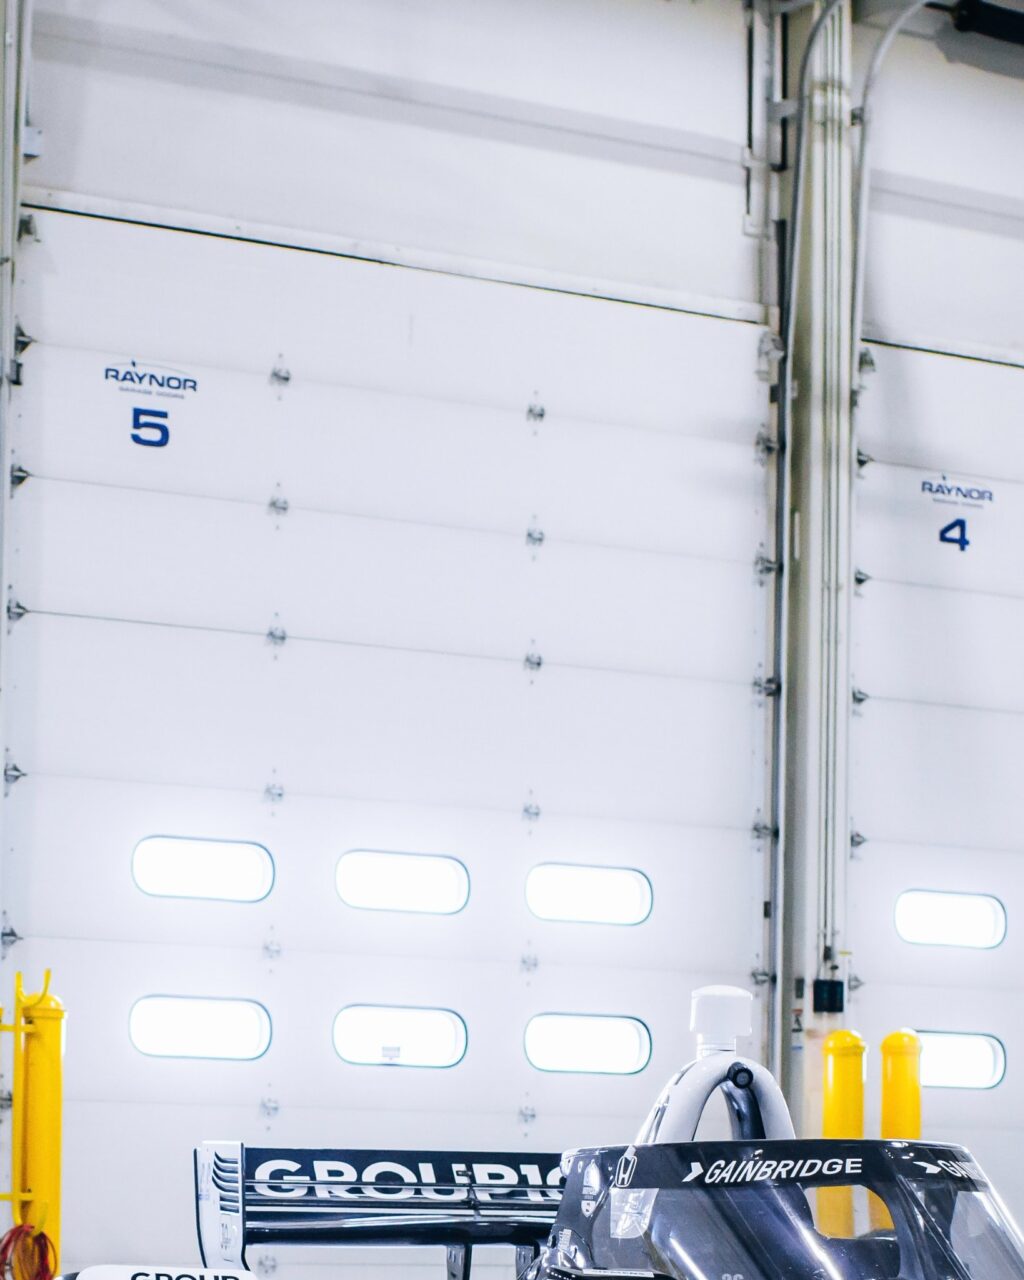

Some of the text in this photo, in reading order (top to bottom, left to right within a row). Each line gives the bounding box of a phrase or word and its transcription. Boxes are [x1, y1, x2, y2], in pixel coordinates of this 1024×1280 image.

[104, 367, 198, 392] RAYNOR
[131, 407, 169, 447] 5
[921, 481, 993, 501] RAYNOR
[939, 518, 970, 551] 4
[704, 1158, 863, 1184] GAINBRIDGE
